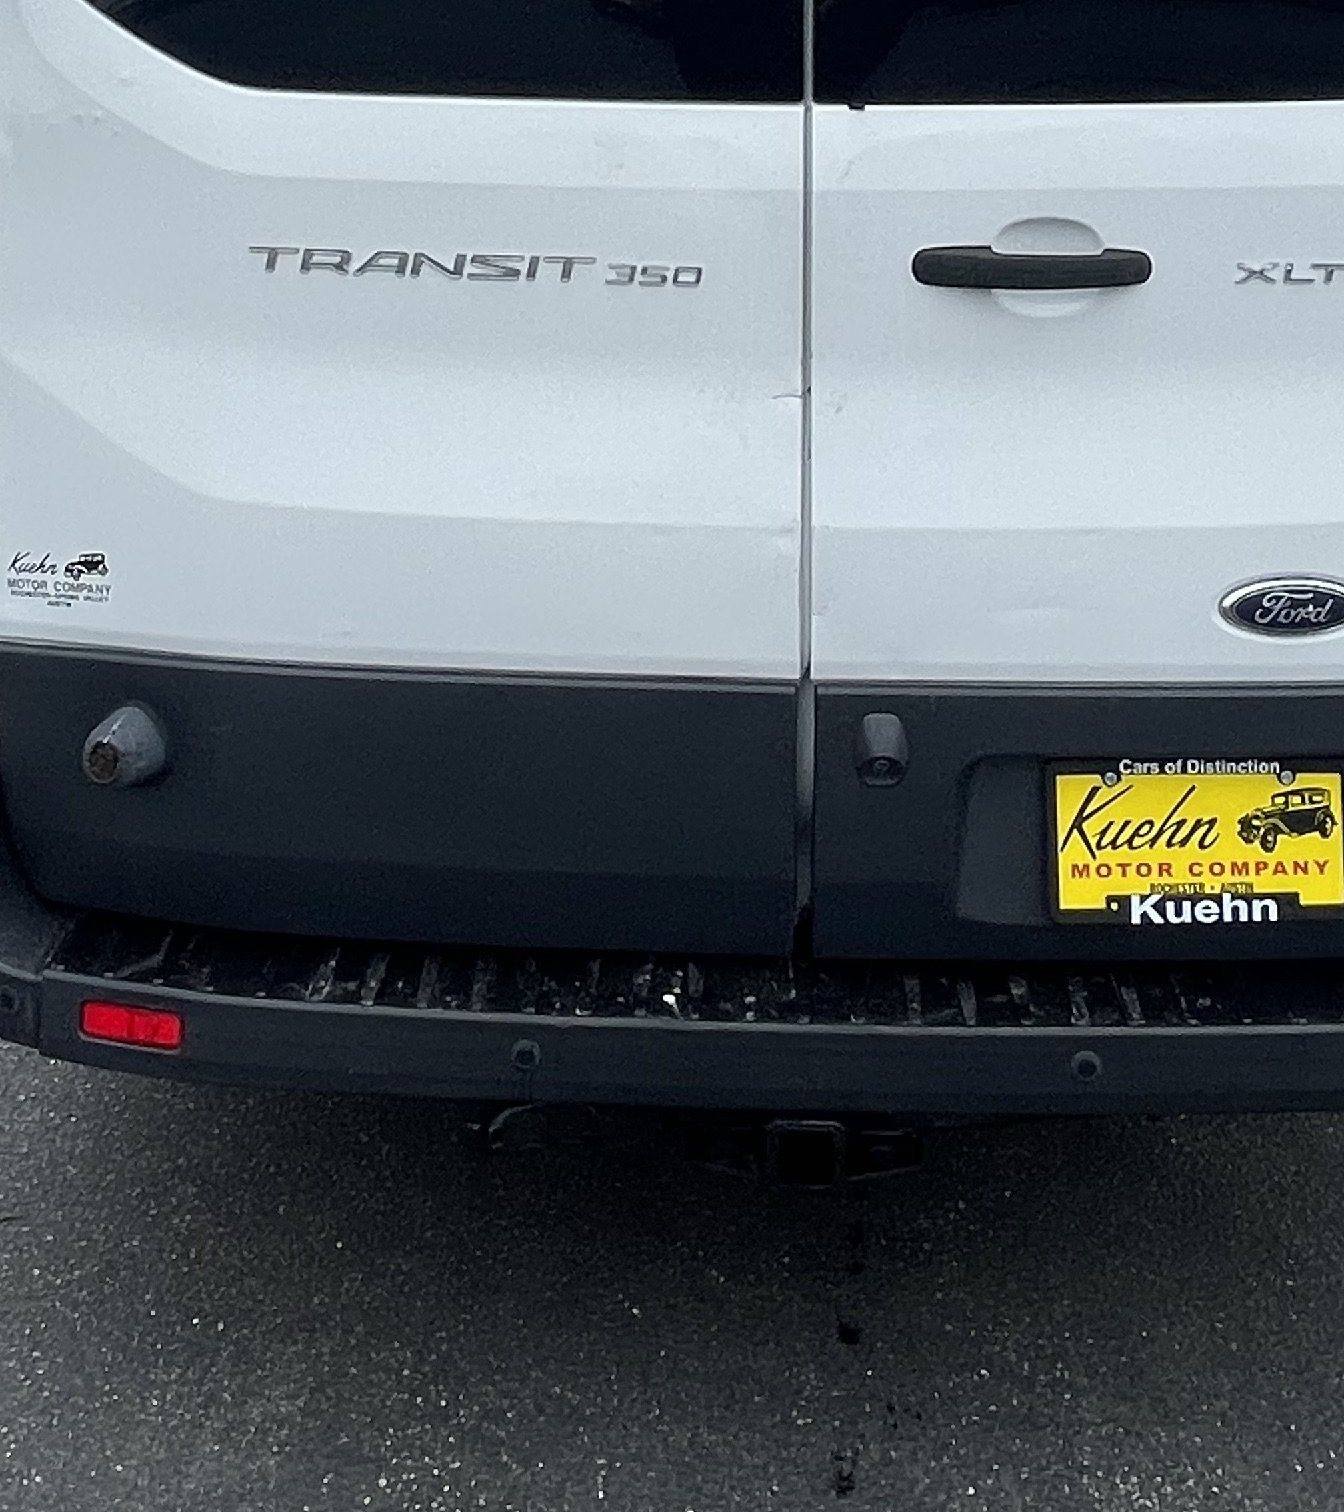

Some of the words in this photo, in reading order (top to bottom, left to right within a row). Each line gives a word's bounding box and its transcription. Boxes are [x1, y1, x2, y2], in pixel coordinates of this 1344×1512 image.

[248, 245, 597, 284] TRANSIT
[605, 262, 703, 288] 350
[7, 551, 58, 576] Kuehn
[7, 578, 48, 590] MOTOR
[53, 580, 112, 596] COMPANY
[1254, 592, 1334, 624] Ford
[1118, 759, 1160, 774] Cars
[1164, 758, 1183, 774] of
[1186, 758, 1280, 774] Distinction
[1059, 784, 1221, 860] Kuehn
[1070, 861, 1173, 879] MOTOR
[1188, 859, 1330, 877] COMPANY
[1129, 892, 1279, 926] Kuehn
